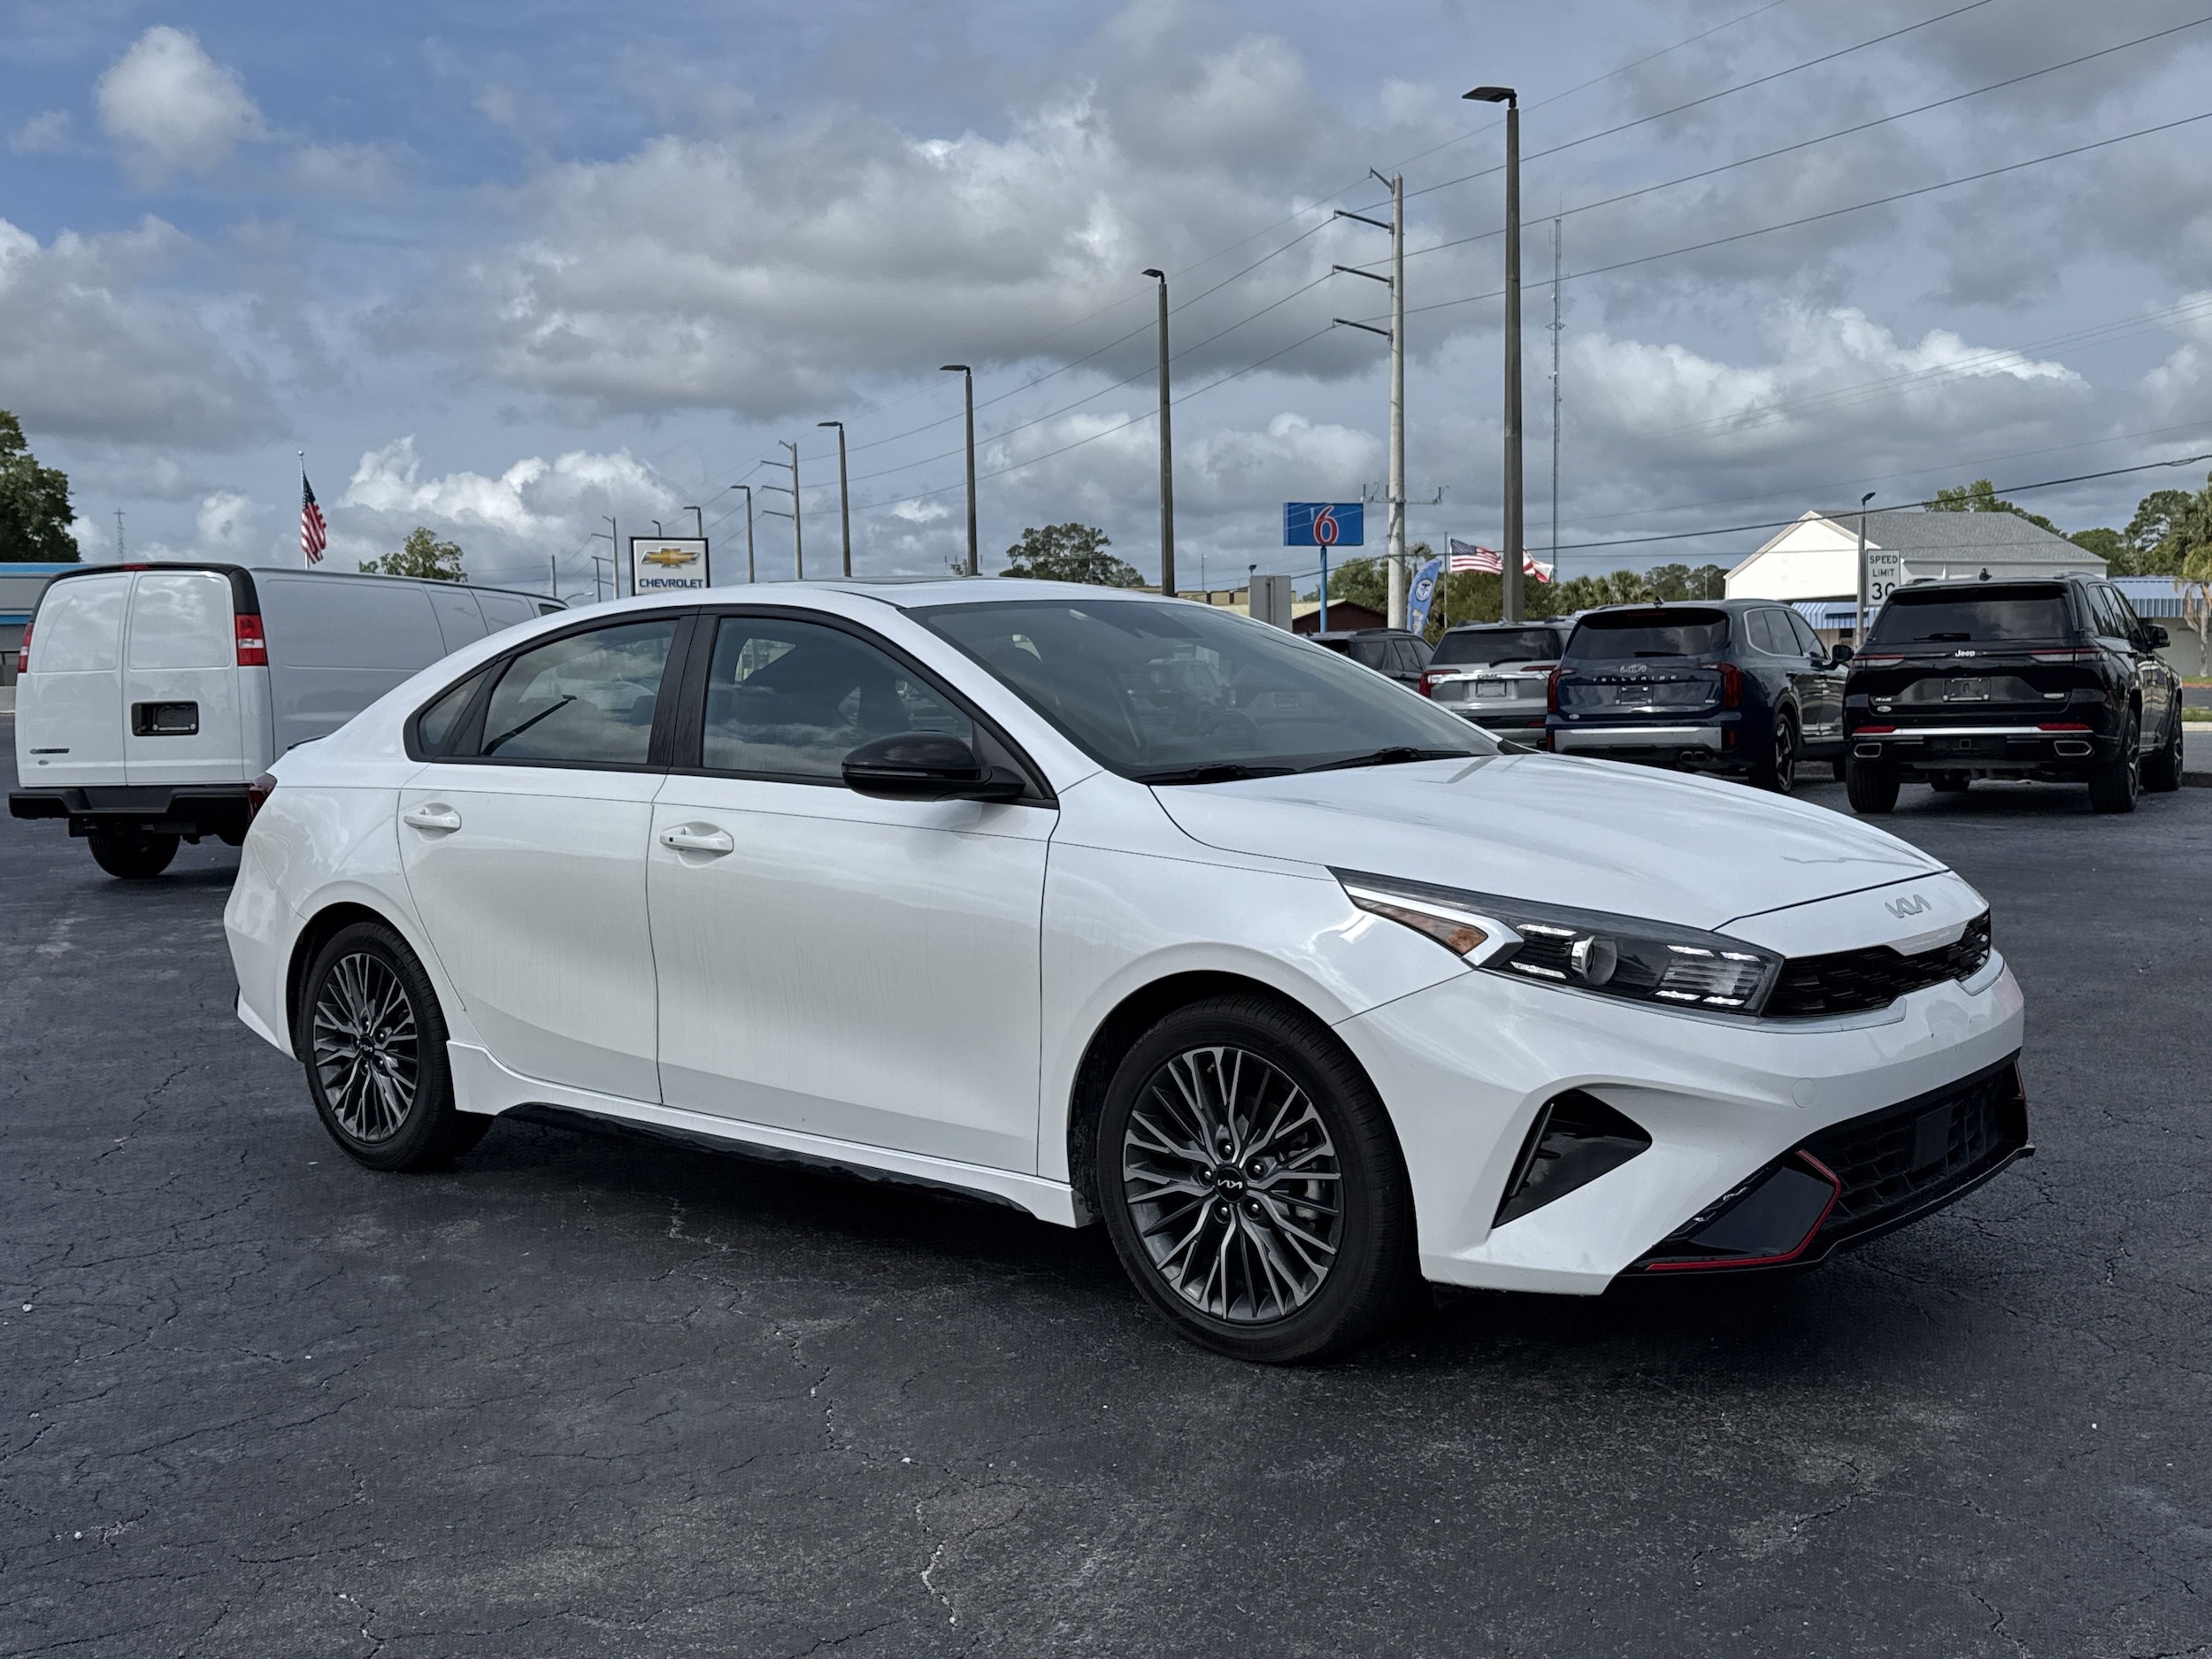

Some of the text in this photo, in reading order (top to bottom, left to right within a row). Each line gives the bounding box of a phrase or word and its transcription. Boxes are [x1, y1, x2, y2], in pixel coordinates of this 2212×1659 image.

[1313, 505, 1339, 545] 6
[1870, 555, 1898, 565] SPEED
[1872, 568, 1894, 578] LIMIT
[639, 578, 703, 588] CHEVROLET
[1955, 649, 1976, 658] Jeep
[1885, 894, 1932, 919] KIA
